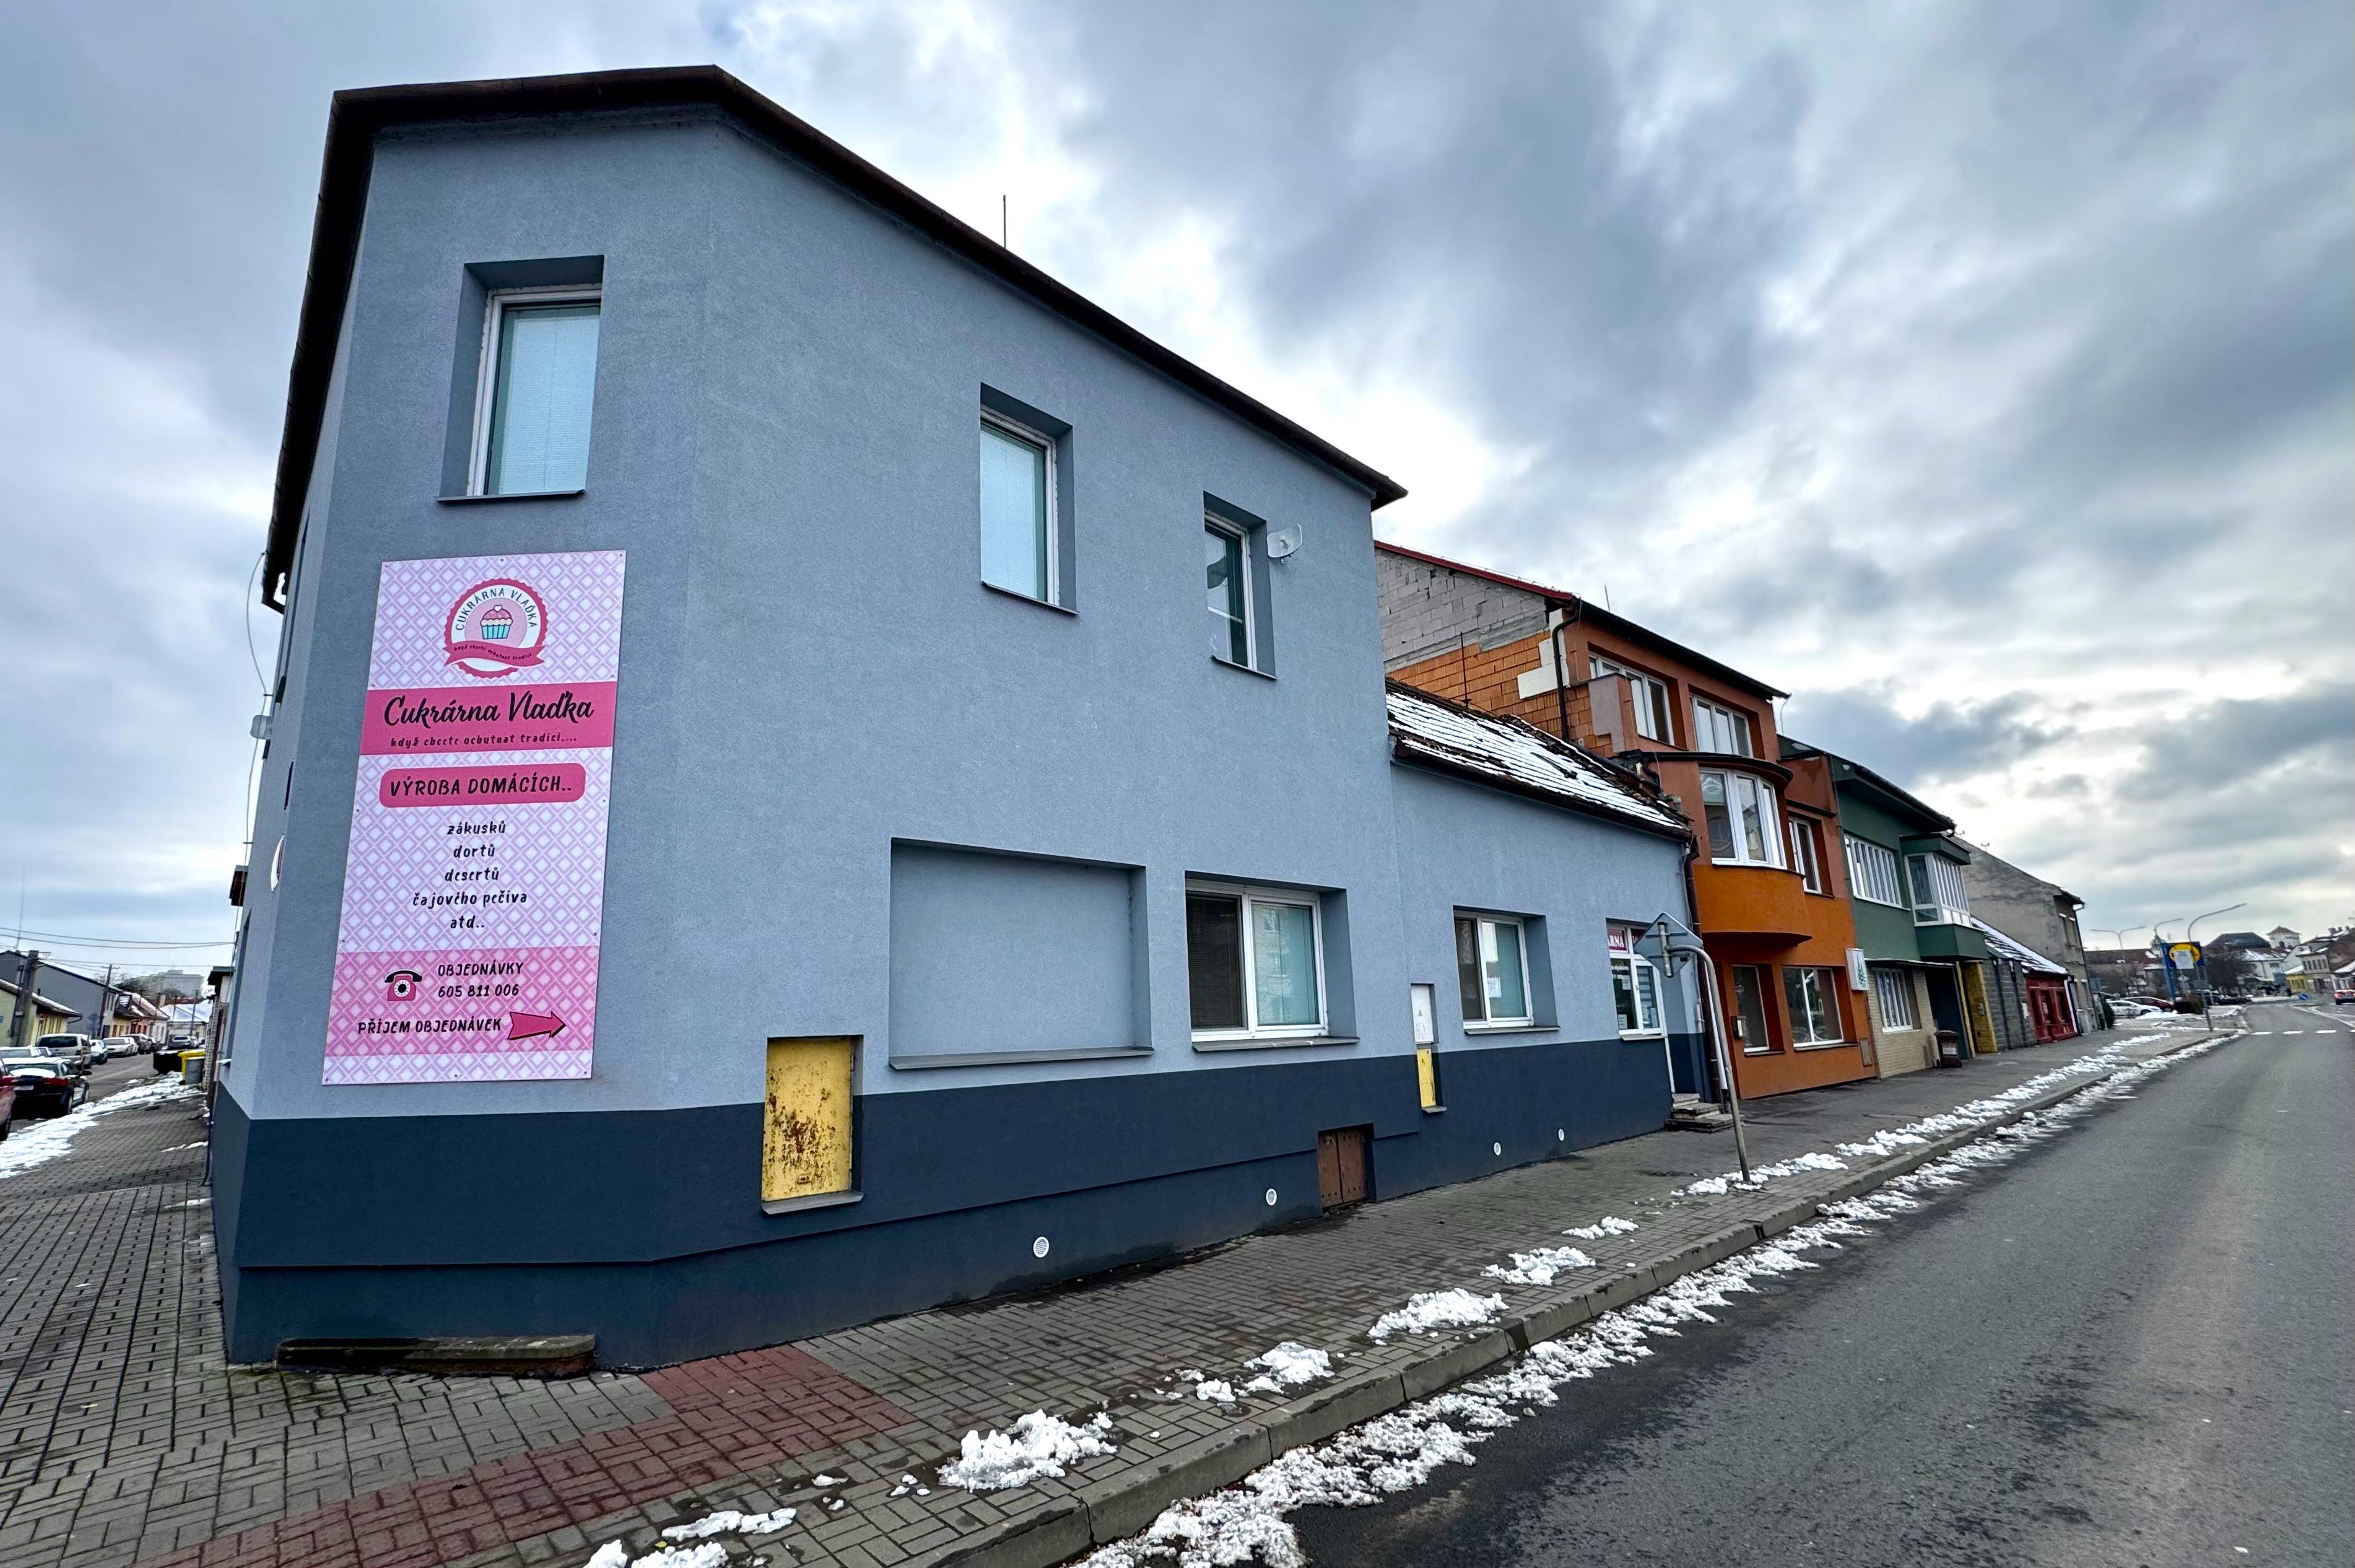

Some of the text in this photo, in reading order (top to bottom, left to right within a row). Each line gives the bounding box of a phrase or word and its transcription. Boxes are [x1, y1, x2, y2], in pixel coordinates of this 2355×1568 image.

[456, 588, 505, 630] CUKRÁRNA
[384, 690, 594, 729] Cukrárna Vlaďka
[391, 737, 419, 749] když
[464, 734, 515, 745] ochutnat
[391, 776, 460, 796] VÝROBA
[446, 821, 506, 835] zákusků
[453, 843, 495, 858] dortů
[445, 867, 499, 882] desertů
[412, 890, 527, 910] čajového pečiva
[438, 960, 524, 977] OBJEDNÁVKY
[438, 983, 520, 998] 605 811 006
[358, 1015, 502, 1035] PŘÍJEM OBJEDNÁVEK
